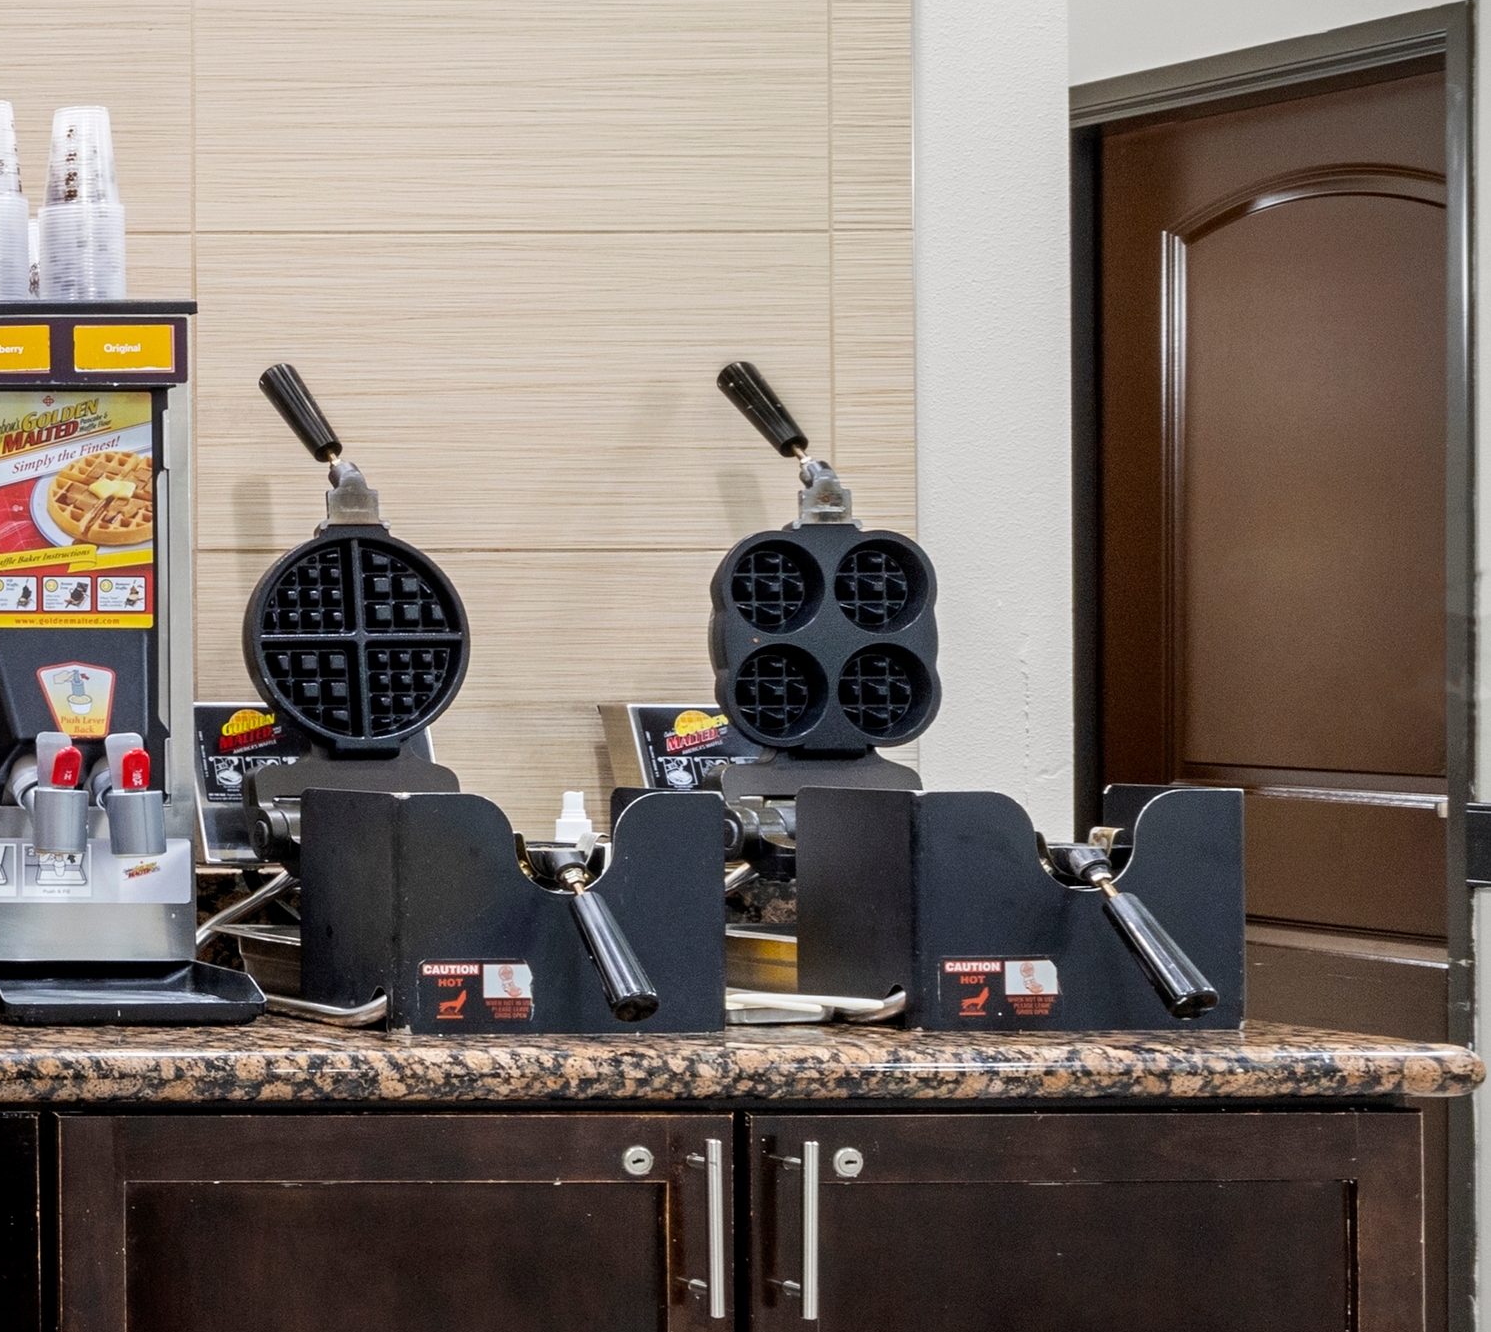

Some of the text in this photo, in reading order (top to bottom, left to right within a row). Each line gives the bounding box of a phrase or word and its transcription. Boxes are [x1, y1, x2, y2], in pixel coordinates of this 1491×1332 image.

[103, 343, 141, 354] Original
[21, 398, 100, 433] GOLDEN
[2, 420, 79, 455] MALTED
[12, 435, 121, 475] Simply the Finest!
[17, 552, 40, 563] Baker
[42, 548, 91, 561] Instructions
[15, 617, 120, 626] www.goldenmalted.com
[61, 716, 105, 724] Push Lever
[222, 714, 275, 736] GOLDEN
[675, 714, 729, 737] GOLDEN
[74, 726, 95, 734] Back
[220, 726, 272, 748] MALTED
[666, 728, 719, 751] MALTED
[423, 965, 479, 974] CAUTION
[945, 962, 1001, 972] CAUTION
[438, 978, 463, 987] HOT
[960, 976, 986, 985] HOT
